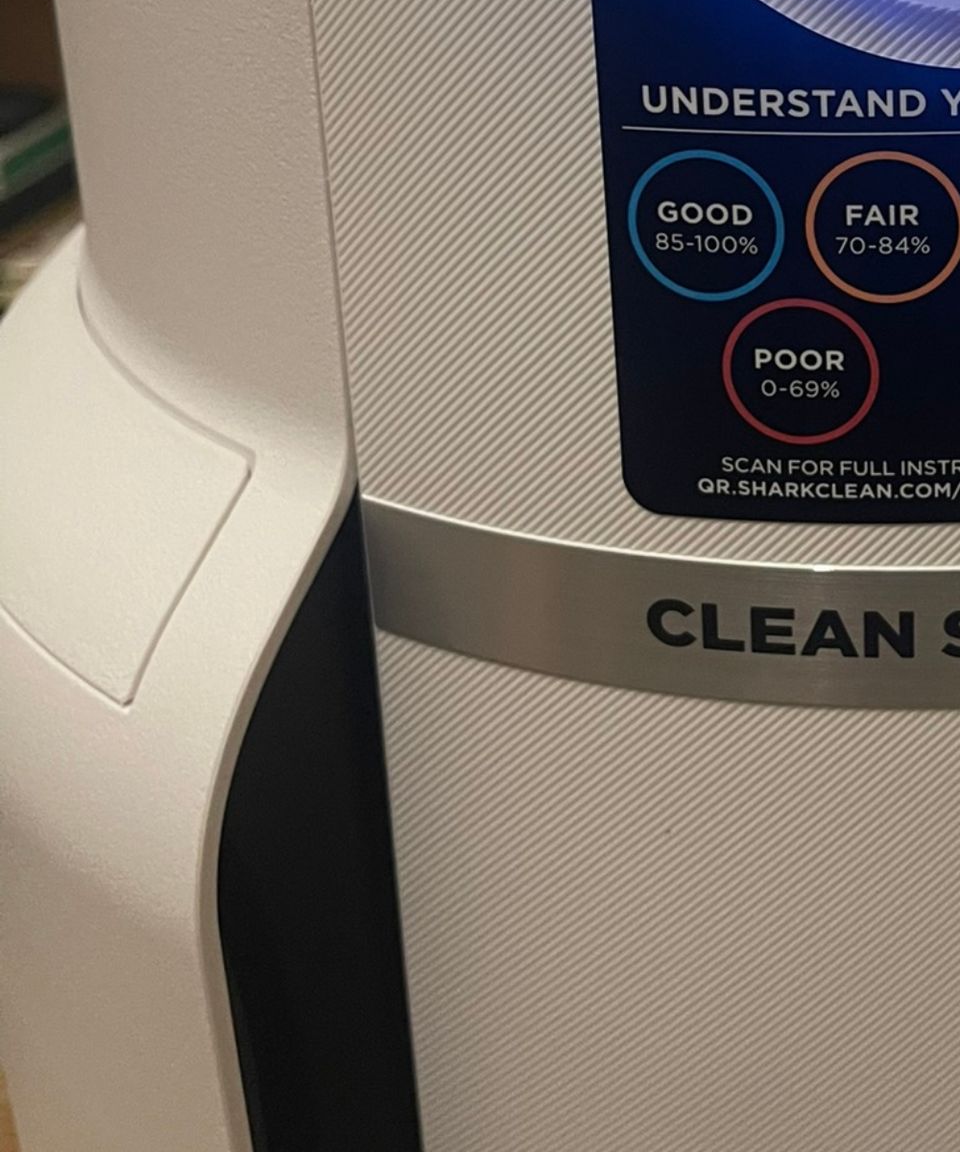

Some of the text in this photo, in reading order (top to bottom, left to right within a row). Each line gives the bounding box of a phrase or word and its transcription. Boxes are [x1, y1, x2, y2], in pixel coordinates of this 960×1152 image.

[641, 84, 926, 117] UNDERSTAND
[657, 200, 753, 226] GOOD
[845, 204, 919, 226] FAIR
[655, 232, 758, 255] 85-100%
[836, 236, 931, 255] 70-84%
[754, 348, 845, 372] POOR
[761, 379, 840, 399] 0-69%
[721, 456, 782, 474] SCAN
[788, 459, 833, 476] FOR
[839, 460, 895, 476] FULL
[646, 598, 914, 658] CLEAN
